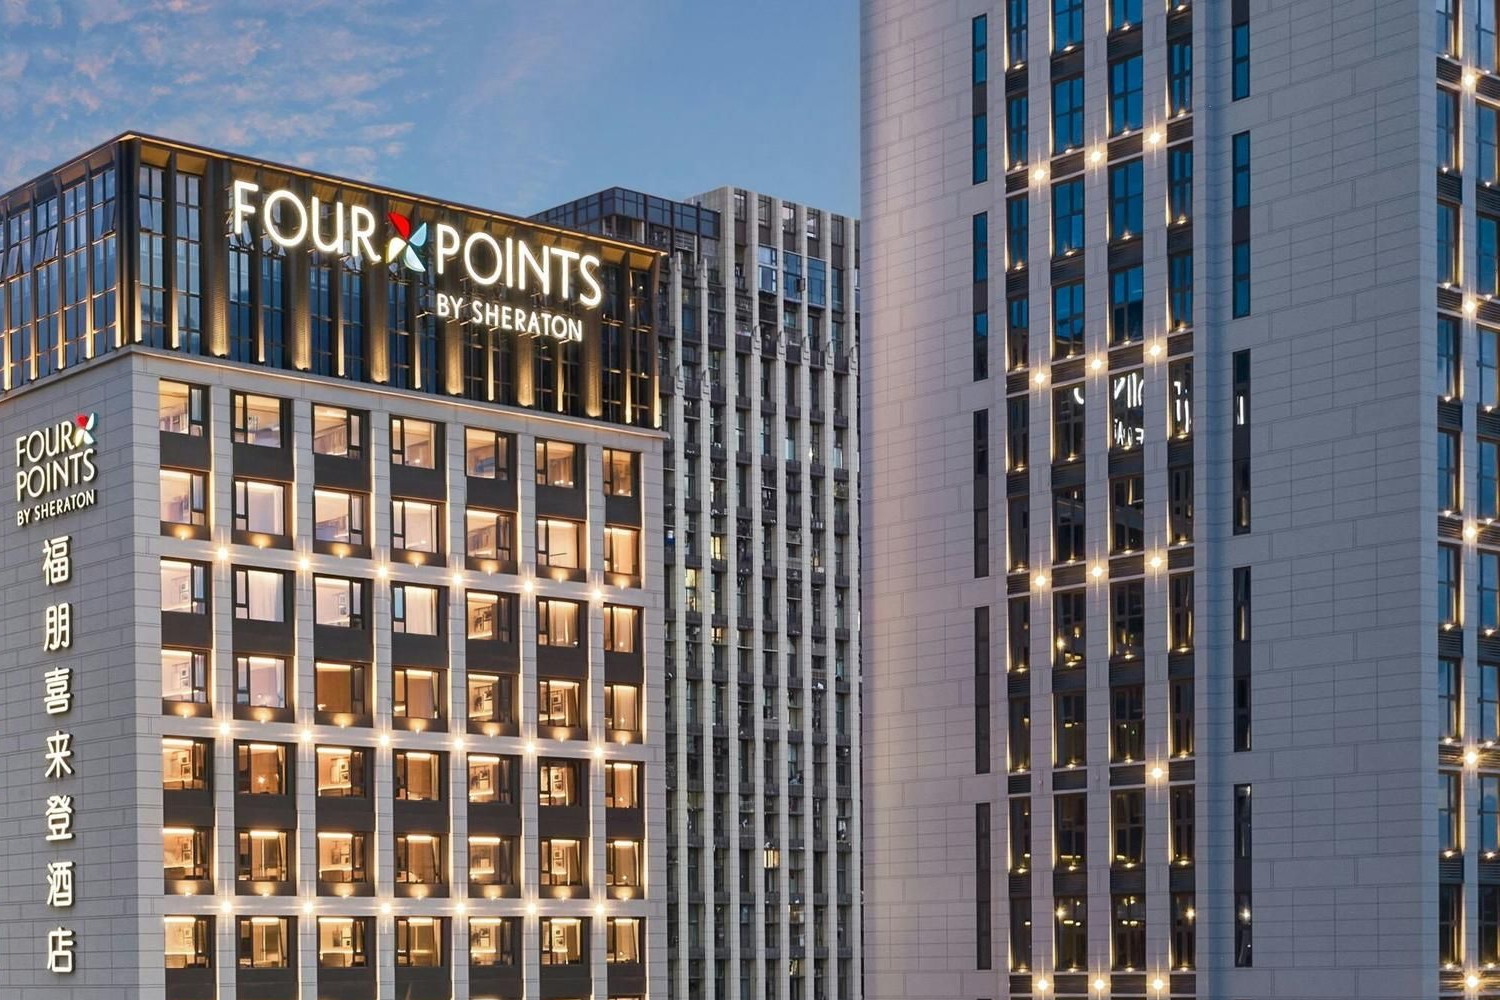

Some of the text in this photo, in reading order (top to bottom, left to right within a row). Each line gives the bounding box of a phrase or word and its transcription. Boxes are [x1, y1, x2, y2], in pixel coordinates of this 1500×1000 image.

[233, 179, 602, 306] FOUR POINTS
[436, 293, 583, 342] BY SHERATON
[16, 420, 75, 467] FOUR
[16, 448, 96, 502] POINTS
[17, 489, 95, 526] BY SHERATON
[42, 535, 75, 975] 福朋喜来登酒店
